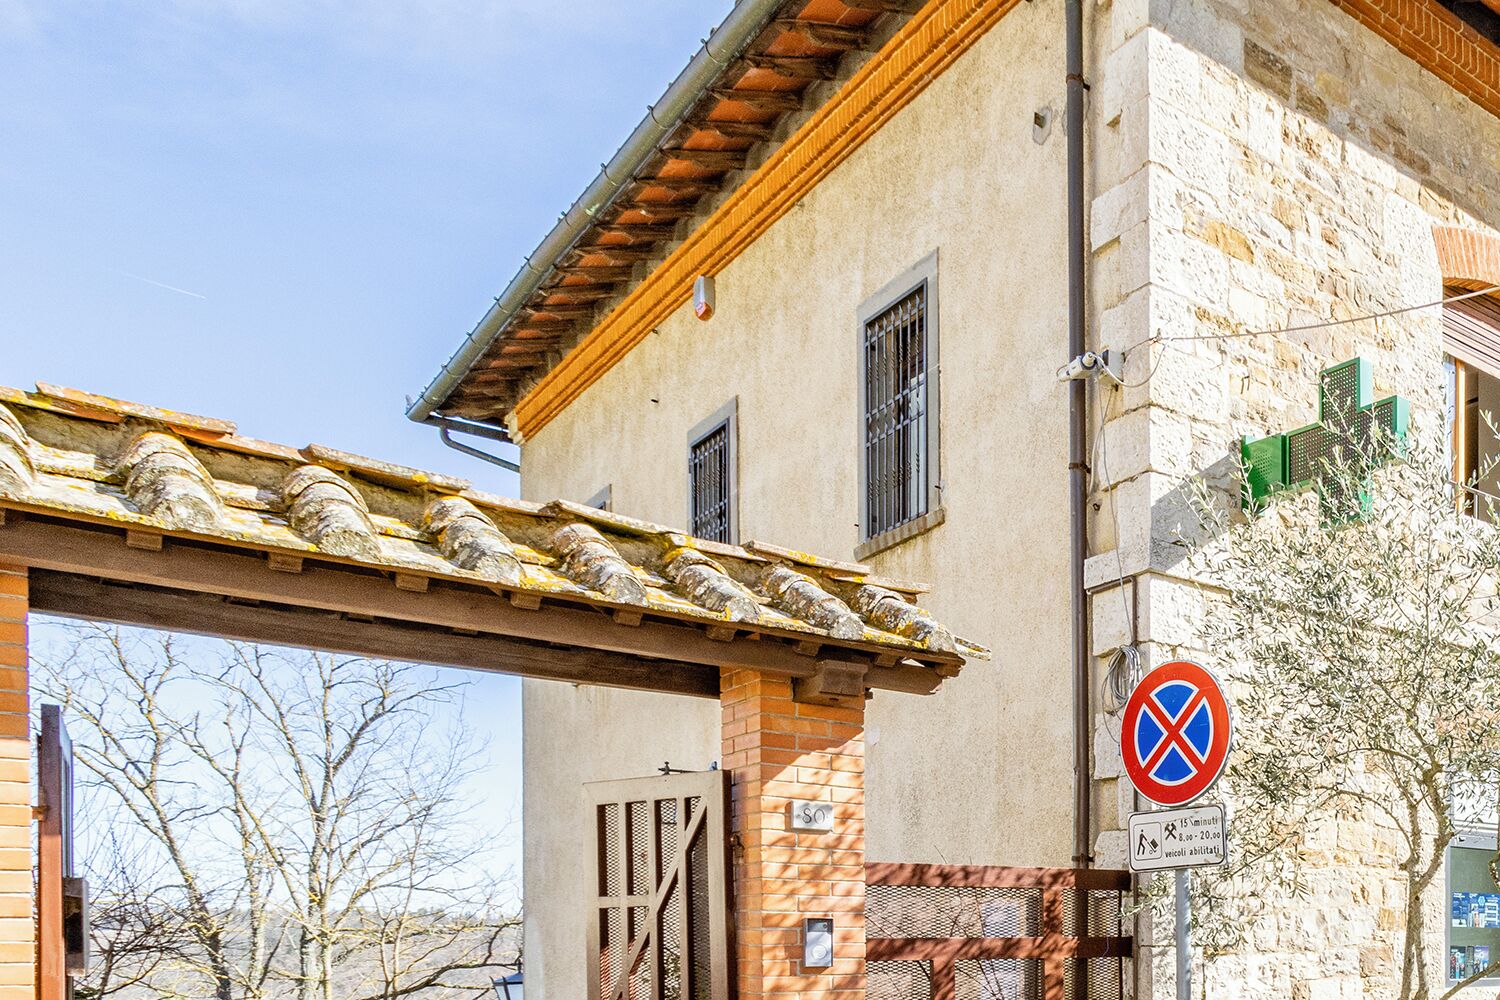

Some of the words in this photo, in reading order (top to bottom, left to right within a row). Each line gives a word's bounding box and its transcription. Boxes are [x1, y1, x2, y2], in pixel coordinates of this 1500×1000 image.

[1180, 818, 1189, 828] 15
[1193, 816, 1218, 827] minuti
[1179, 833, 1193, 842] 8.00
[1200, 830, 1220, 840] 20.00
[1165, 848, 1187, 858] veicoli
[1189, 845, 1220, 856] abilitati
